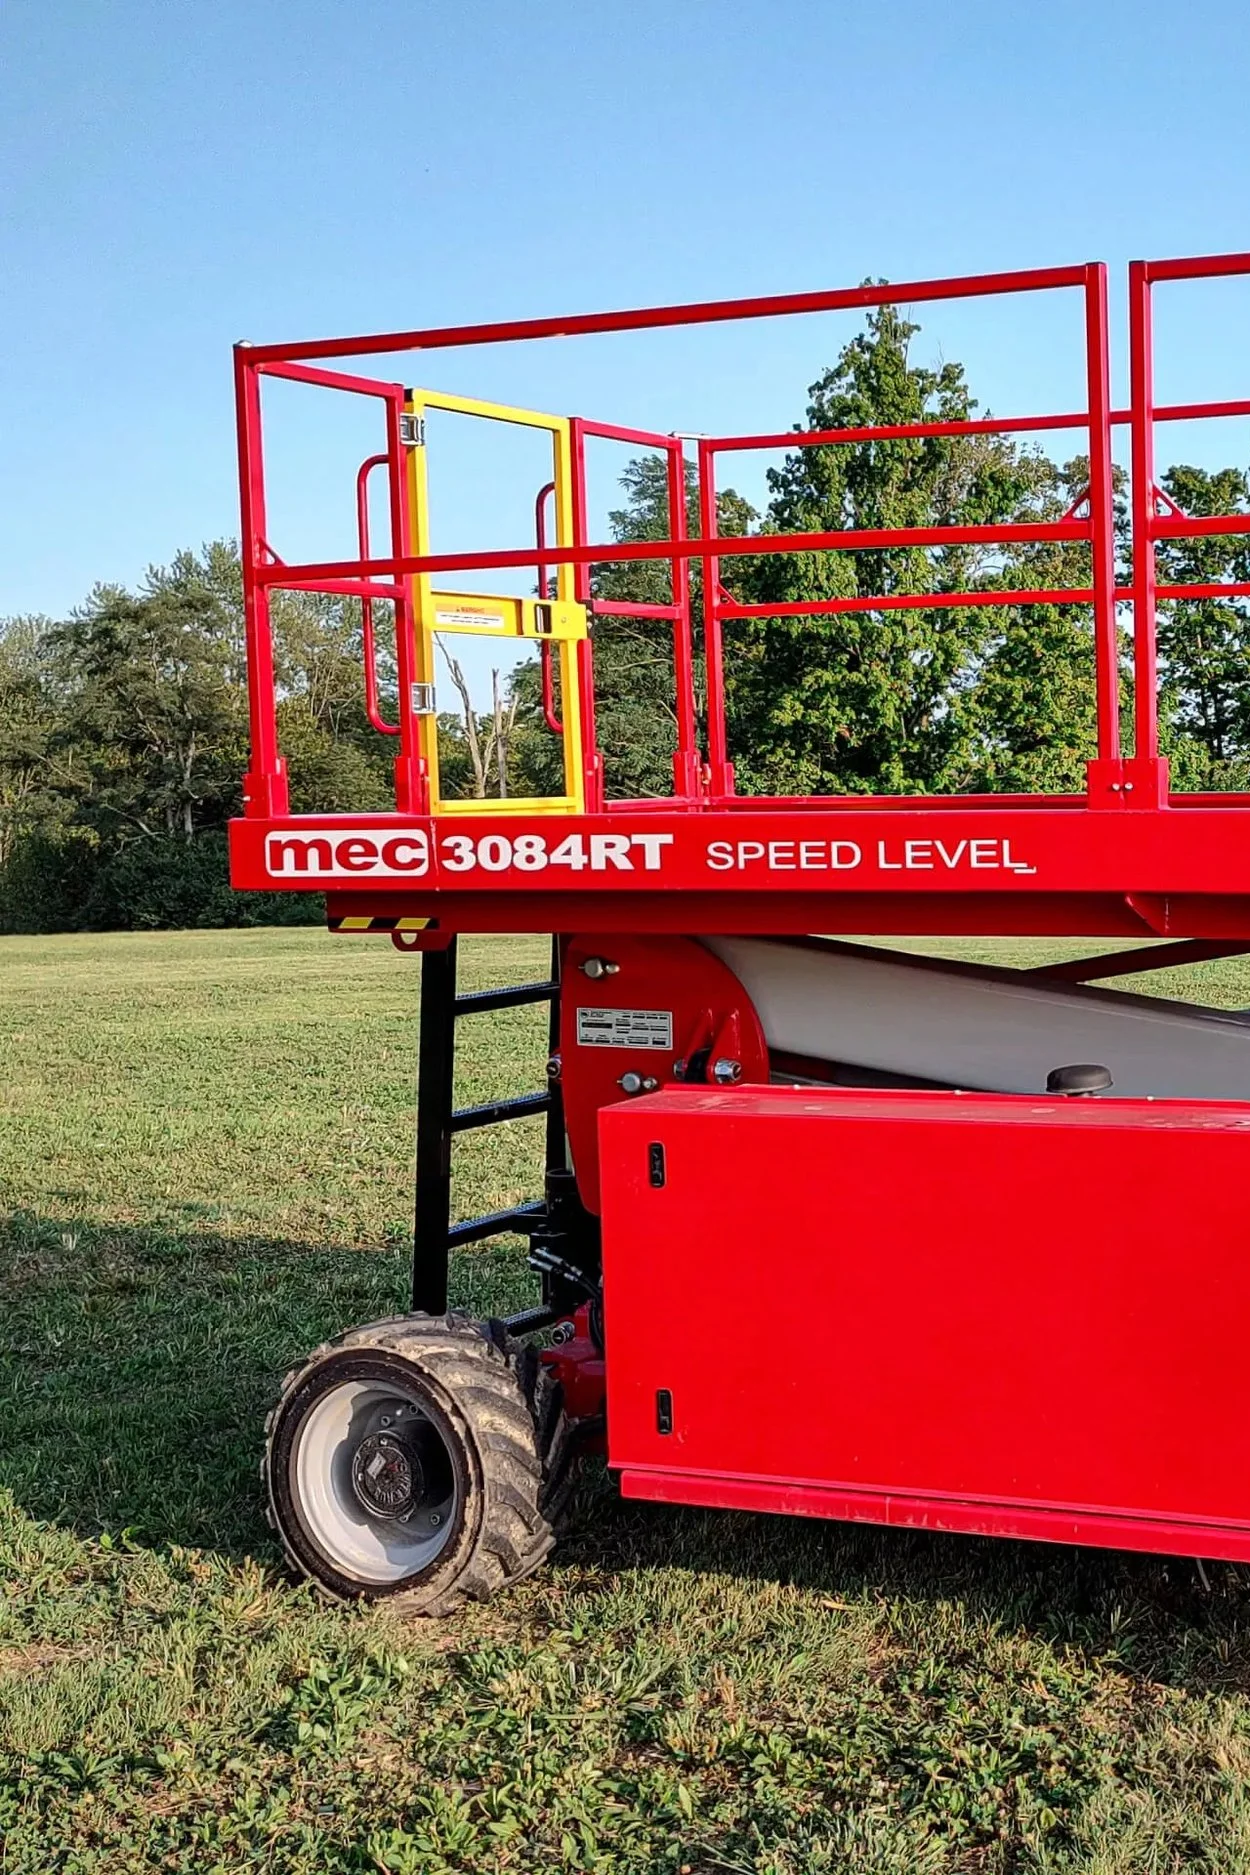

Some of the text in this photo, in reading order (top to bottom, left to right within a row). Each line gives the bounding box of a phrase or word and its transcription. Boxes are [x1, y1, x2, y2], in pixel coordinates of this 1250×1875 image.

[440, 833, 674, 872] 3084RT
[706, 839, 1036, 871] SPEED LEVEL
